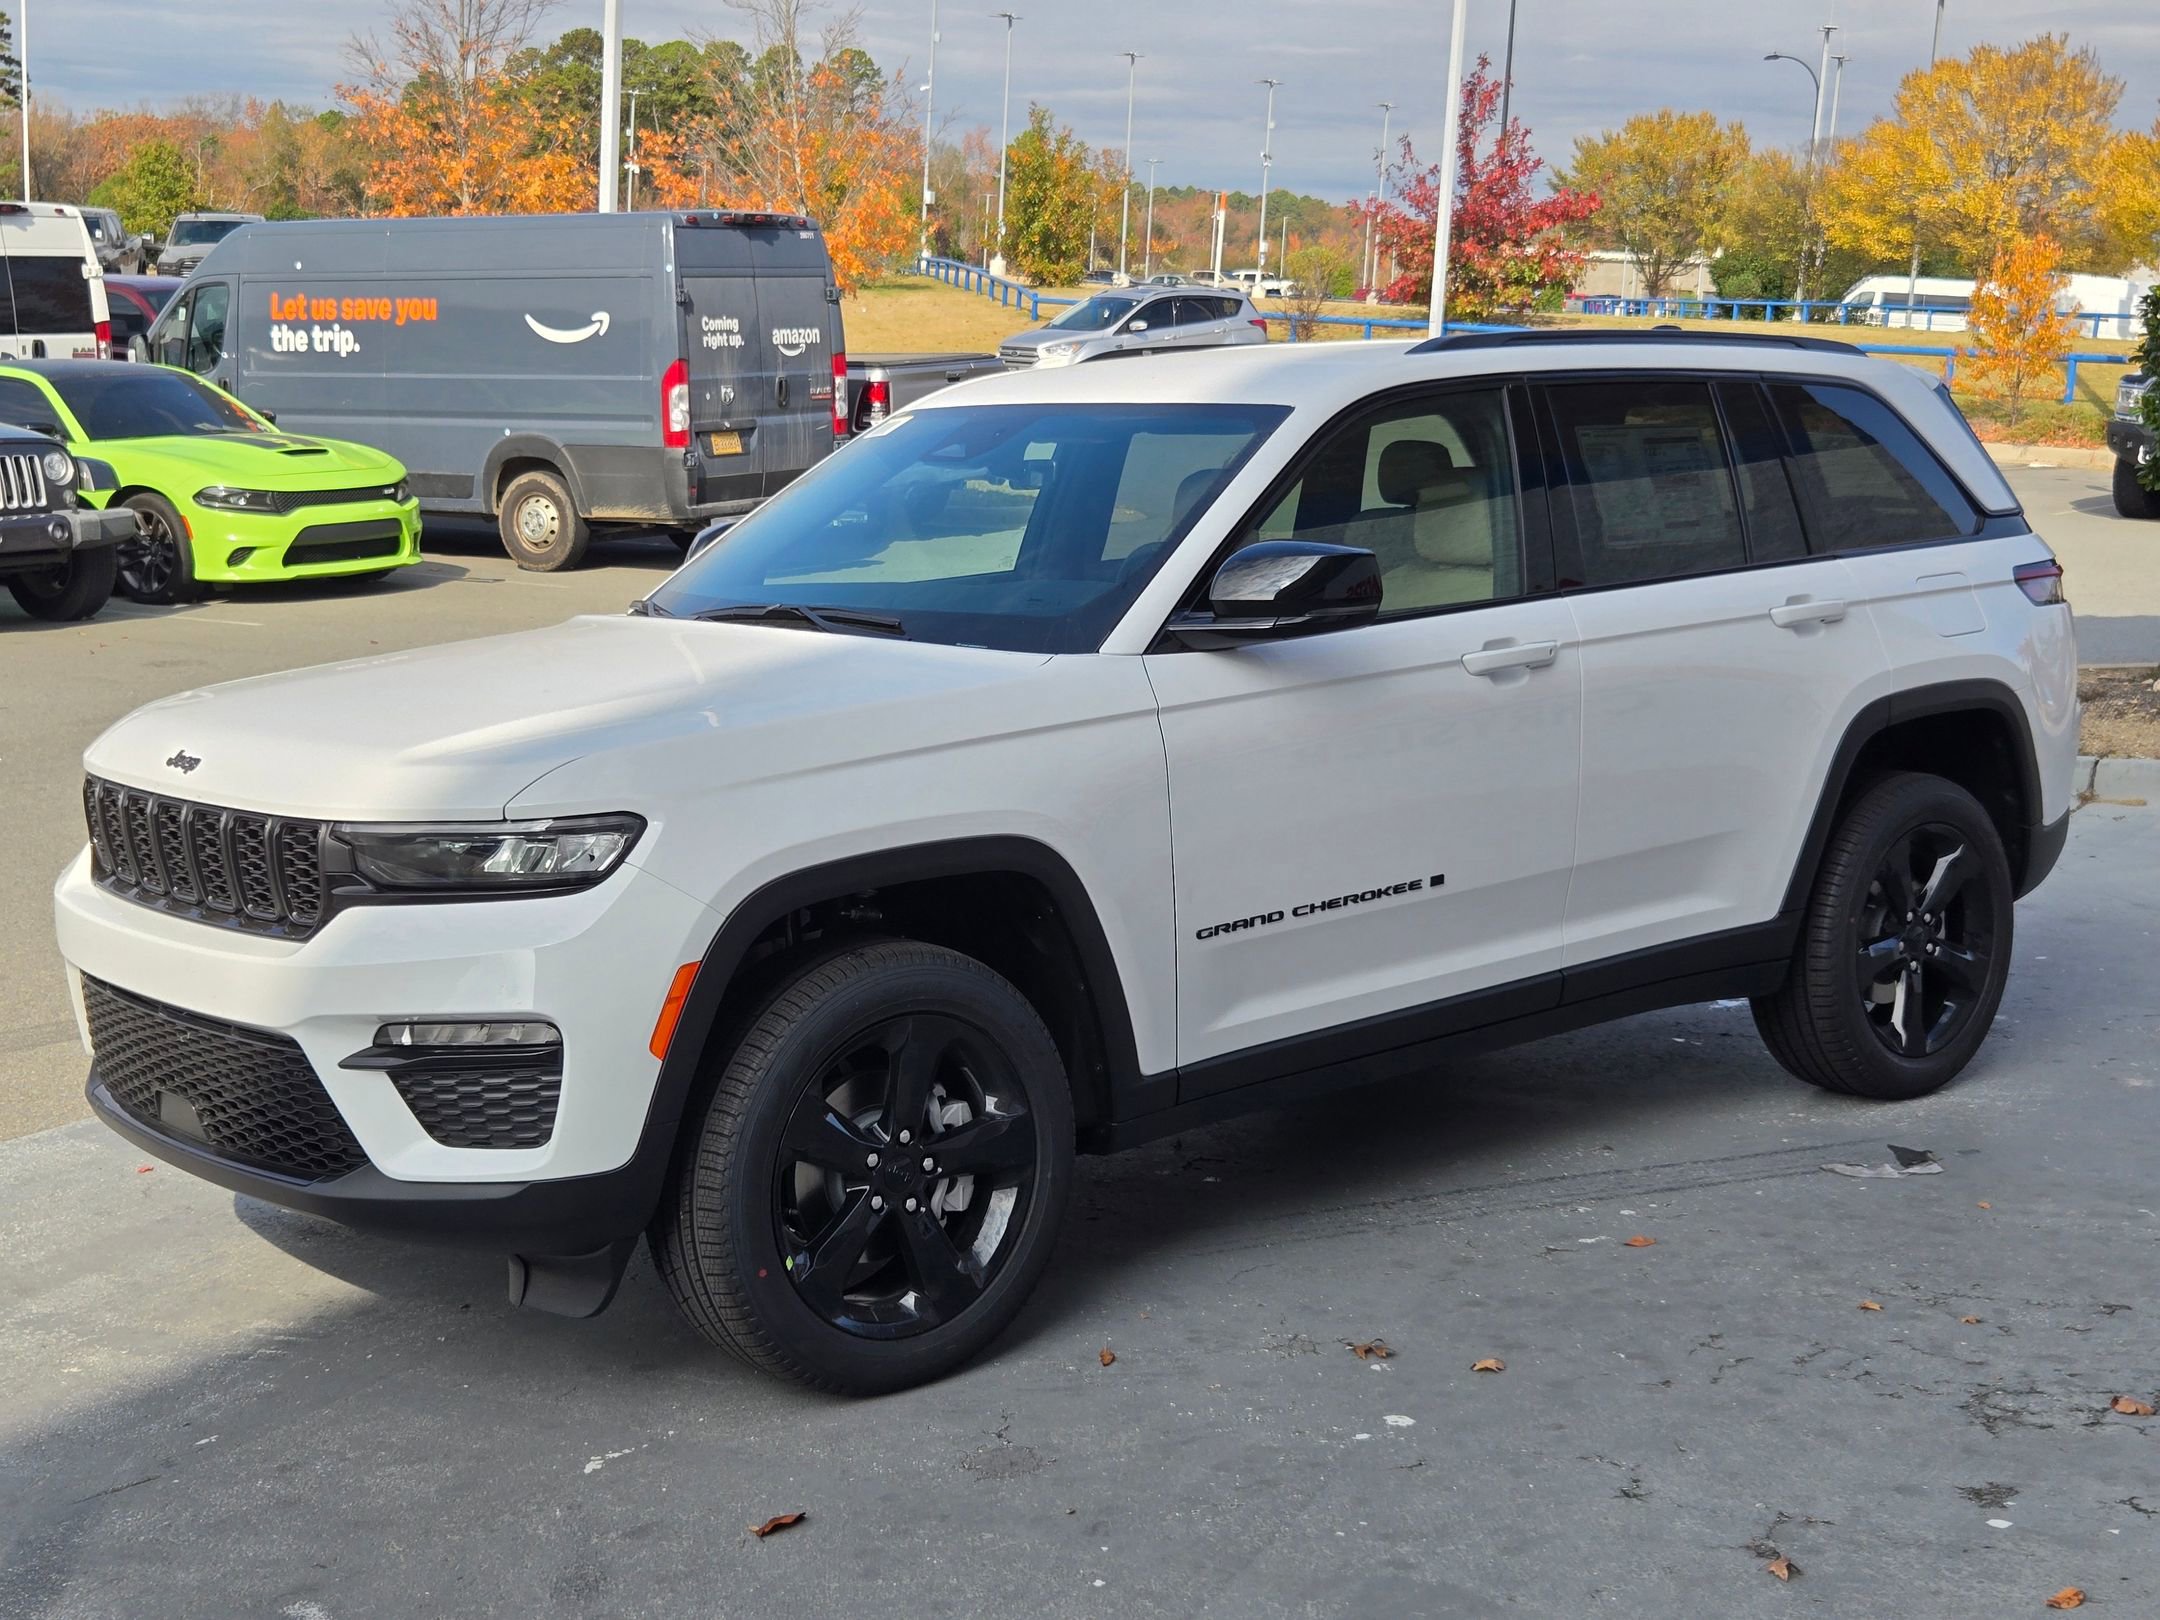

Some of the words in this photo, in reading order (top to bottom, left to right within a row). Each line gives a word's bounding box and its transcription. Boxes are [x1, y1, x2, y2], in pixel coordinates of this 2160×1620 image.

[271, 293, 308, 321] Let
[311, 298, 337, 321] us
[341, 298, 392, 321] save
[395, 298, 438, 326] you
[702, 316, 739, 333] Coming
[772, 328, 820, 345] amazon
[270, 324, 309, 352] the
[311, 324, 360, 358] trip.
[703, 333, 728, 350] right
[729, 334, 744, 348] up.
[166, 749, 202, 775] Jeep
[1196, 910, 1284, 940] GRAND
[1292, 879, 1423, 917] CHEROKEE
